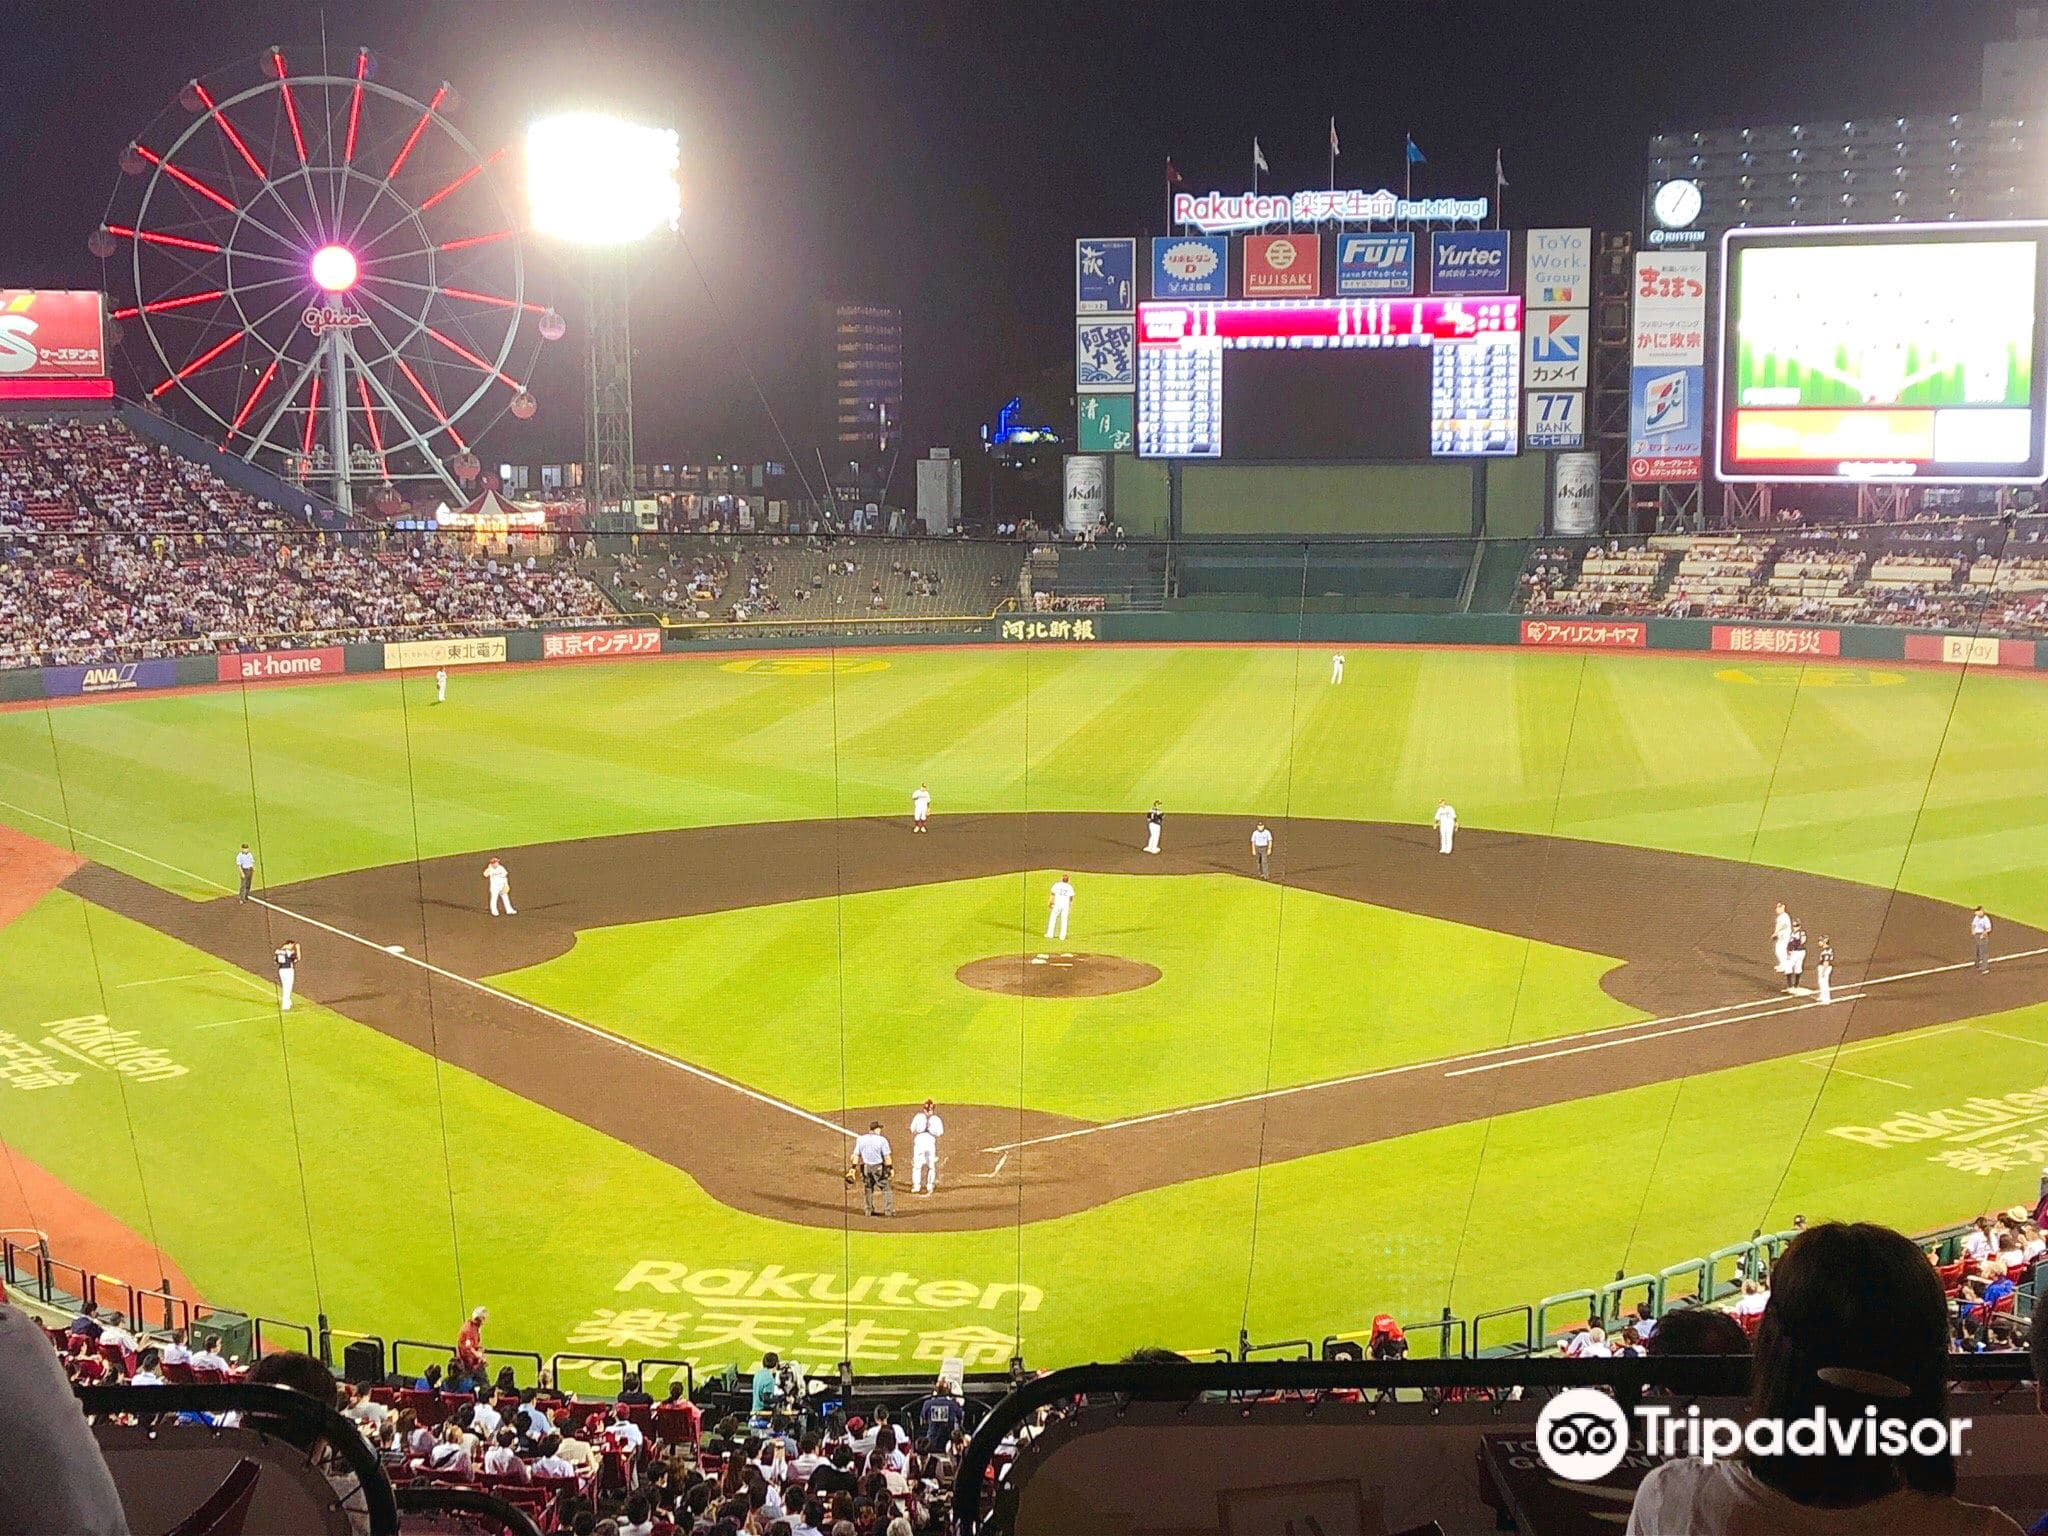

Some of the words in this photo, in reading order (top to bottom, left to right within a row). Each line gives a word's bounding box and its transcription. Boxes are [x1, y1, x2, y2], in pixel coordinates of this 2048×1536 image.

[1175, 192, 1289, 222] Rakuten
[1293, 190, 1396, 219] 楽天生命
[1399, 201, 1433, 217] Park
[1437, 199, 1486, 217] Miyagi
[1537, 235, 1582, 250] ToYo
[1343, 239, 1409, 268] Fuji
[1438, 245, 1501, 266] Yurtec
[1185, 264, 1197, 274] D
[1249, 273, 1312, 285] FUJISAKI
[1535, 272, 1581, 285] Group
[1638, 266, 1704, 299] まるまつ
[39, 348, 99, 360] ケーズデンキ
[1532, 366, 1580, 382] カメイ
[1536, 395, 1575, 421] 77
[1535, 422, 1573, 433] BANK
[1068, 484, 1102, 500] Asahi
[1001, 618, 1096, 641] 河北新報
[1547, 625, 1640, 643] アイリスオーヤマ
[447, 641, 505, 660] 東北電力
[544, 631, 660, 657] 東京インテリア
[1730, 628, 1821, 655] 能美防災
[83, 667, 118, 685] ANA
[241, 660, 262, 678] at
[264, 655, 322, 676] home
[39, 1014, 190, 1083] Rakuten
[613, 1260, 1045, 1312] Rakuten
[566, 1308, 1026, 1367] 楽天生命
